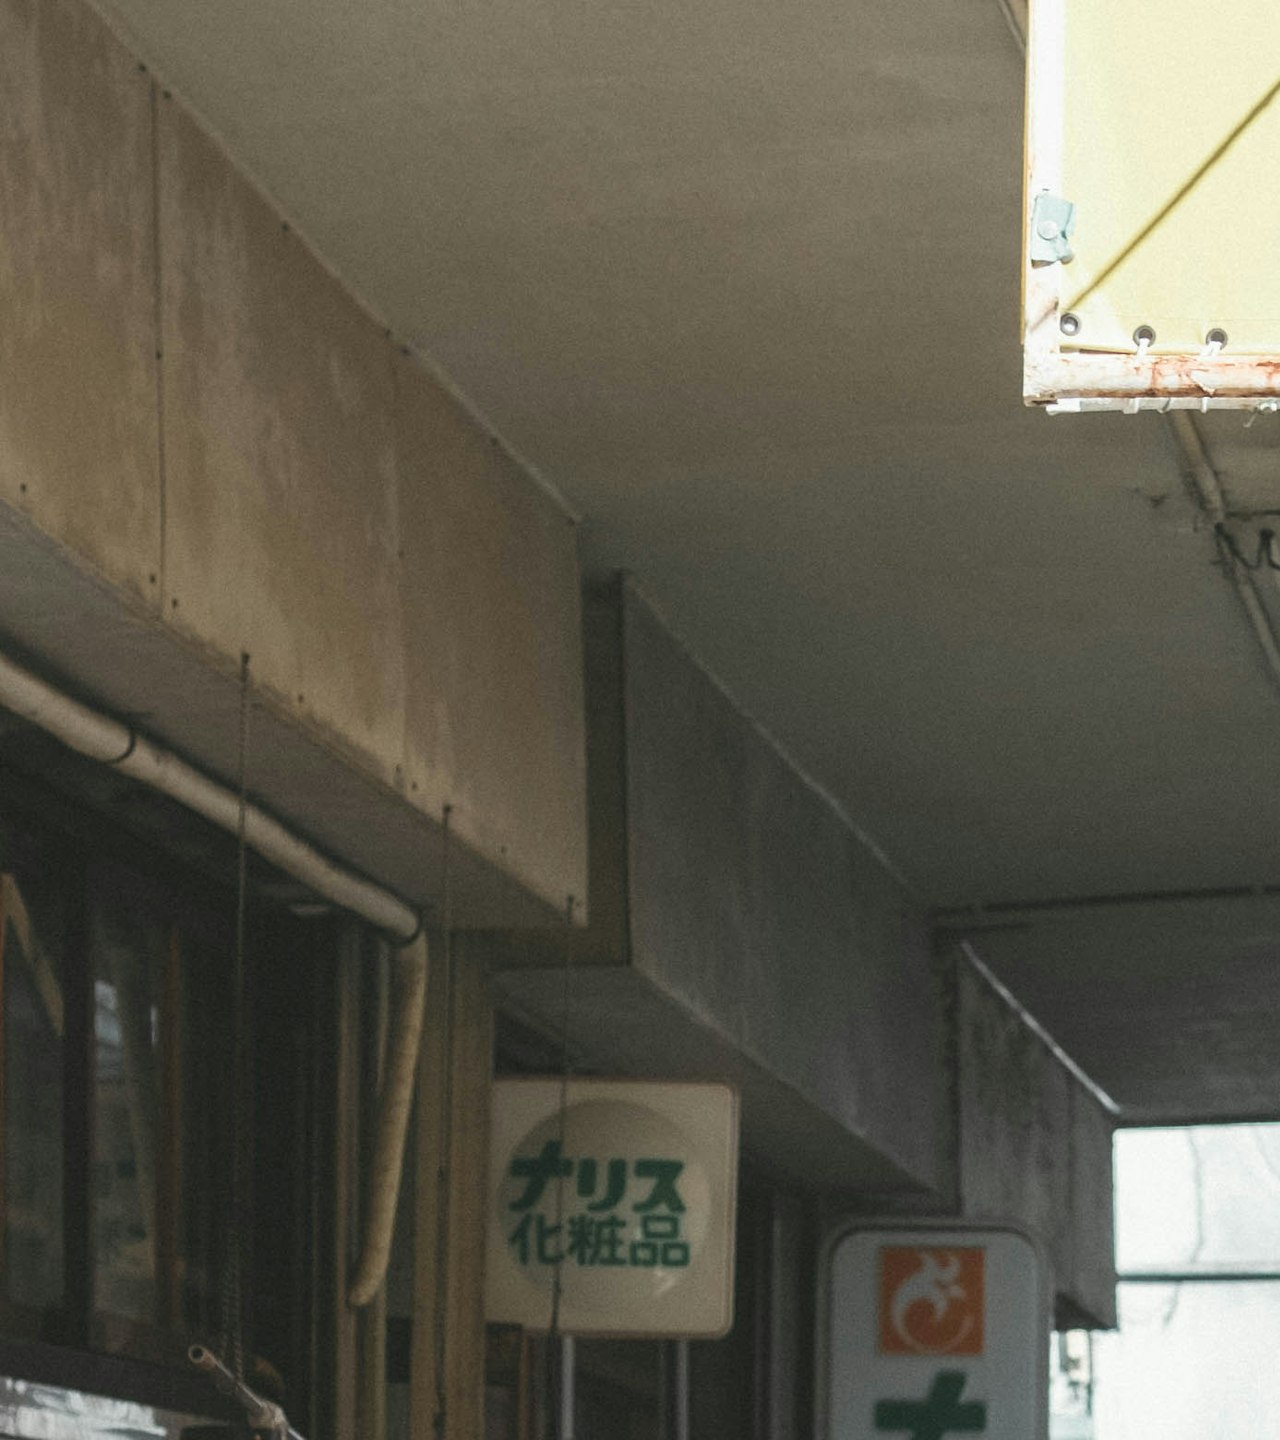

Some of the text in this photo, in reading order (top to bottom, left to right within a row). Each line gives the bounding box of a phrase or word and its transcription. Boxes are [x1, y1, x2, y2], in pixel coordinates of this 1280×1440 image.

[507, 1139, 686, 1211] ナリス
[507, 1213, 691, 1270] 化粧品
